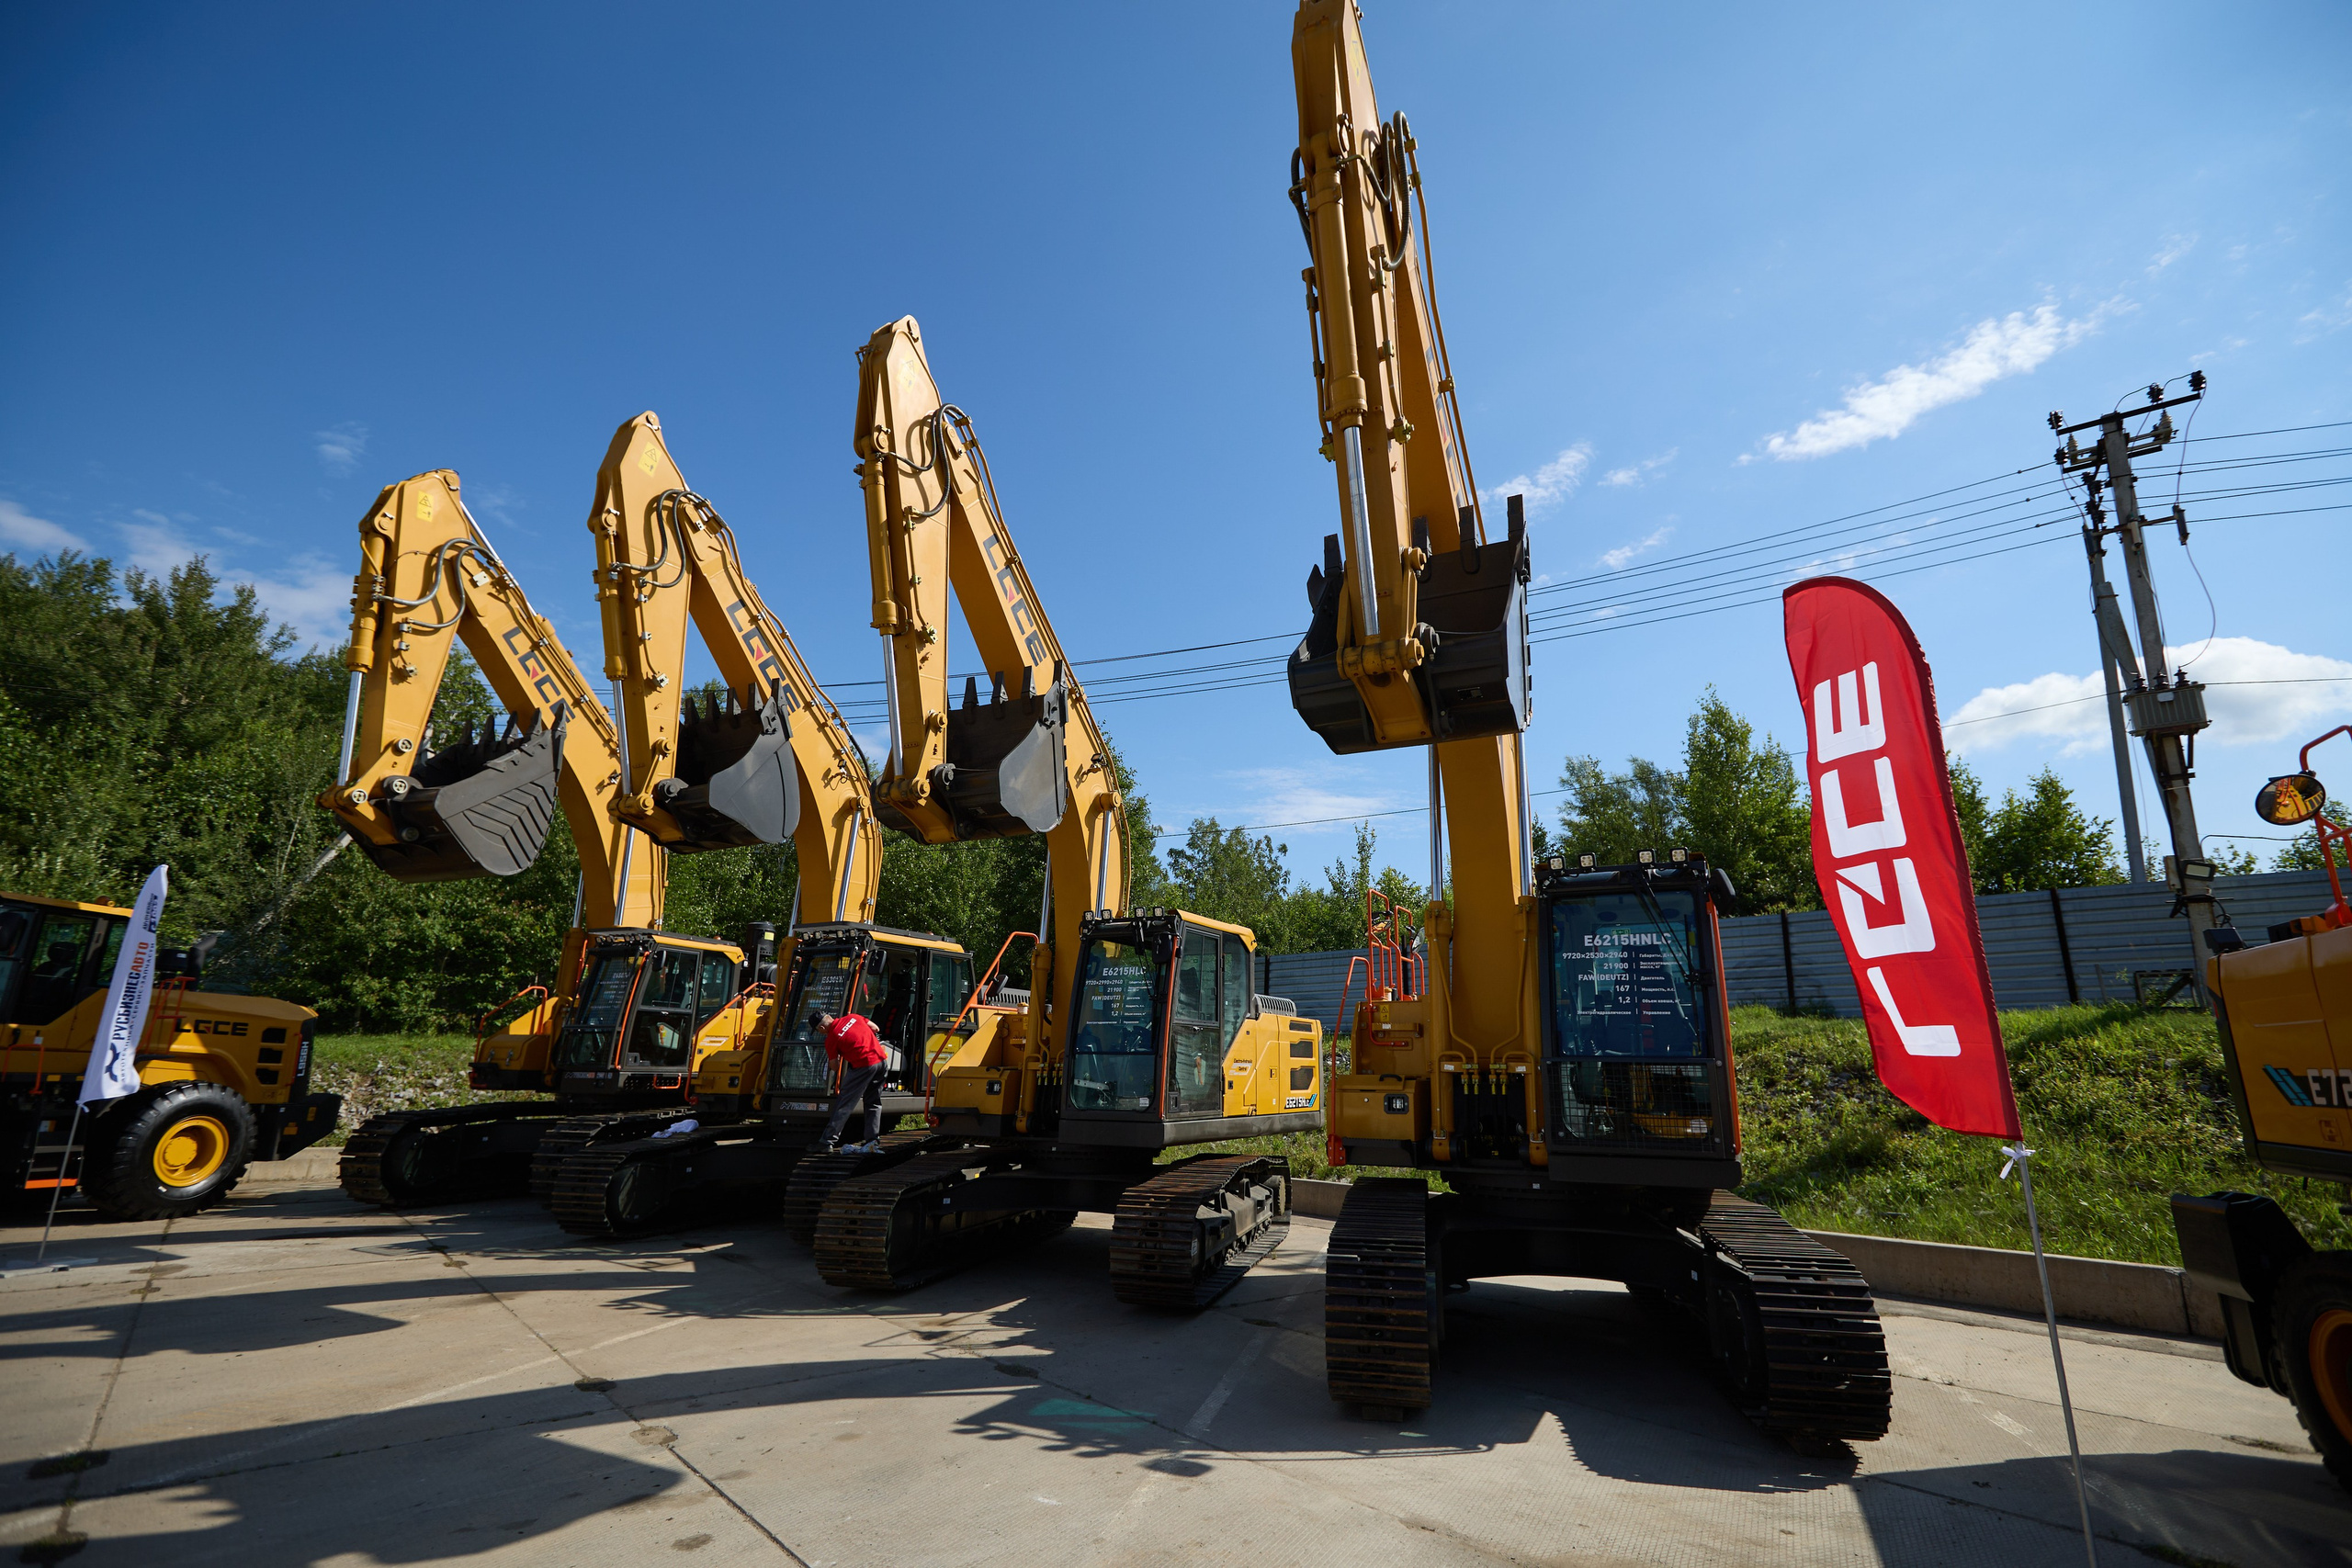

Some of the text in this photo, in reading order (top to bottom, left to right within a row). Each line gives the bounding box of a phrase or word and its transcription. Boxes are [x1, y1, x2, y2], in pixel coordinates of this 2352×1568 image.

[1425, 345, 1468, 507] LGC
[983, 534, 1046, 667] LGCE
[503, 626, 576, 723] LGCE
[1813, 660, 1962, 1057] LGCE
[1584, 933, 1671, 946] E6215HNLC
[175, 1018, 249, 1037] LGCE
[297, 1041, 310, 1077] L956H
